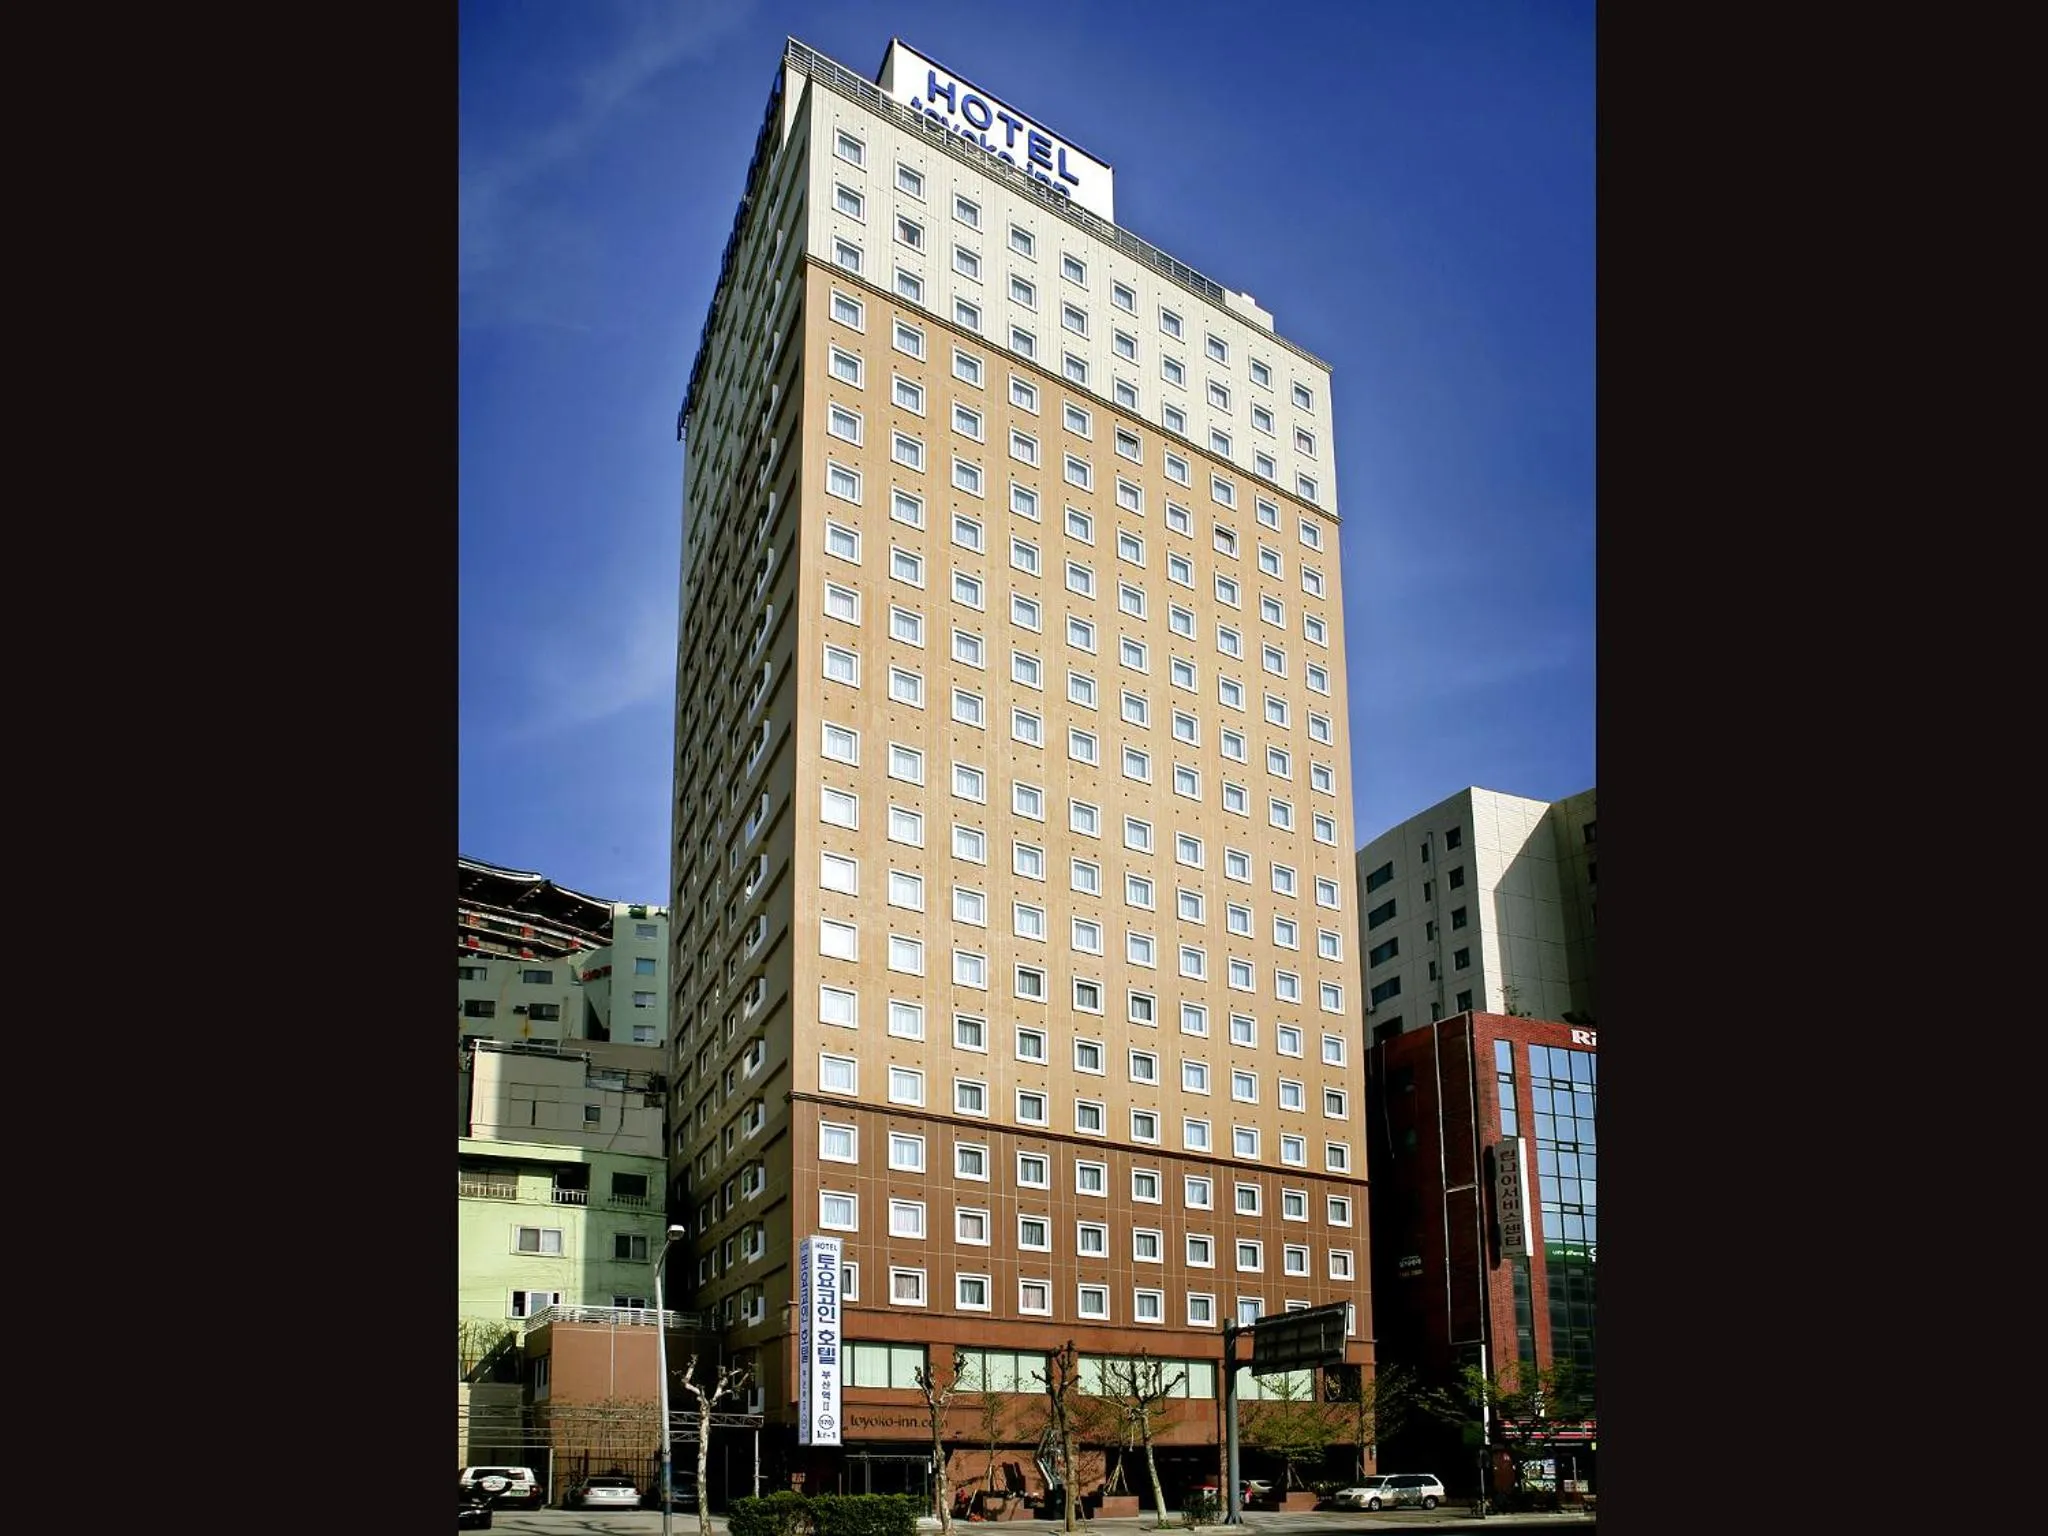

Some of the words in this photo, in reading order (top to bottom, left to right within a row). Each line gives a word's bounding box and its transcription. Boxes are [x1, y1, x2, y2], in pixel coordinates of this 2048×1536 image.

[928, 69, 1079, 186] HOTEL
[815, 1242, 838, 1252] HOTEL
[817, 1253, 836, 1325] 토요코인
[817, 1329, 836, 1365] 호텔
